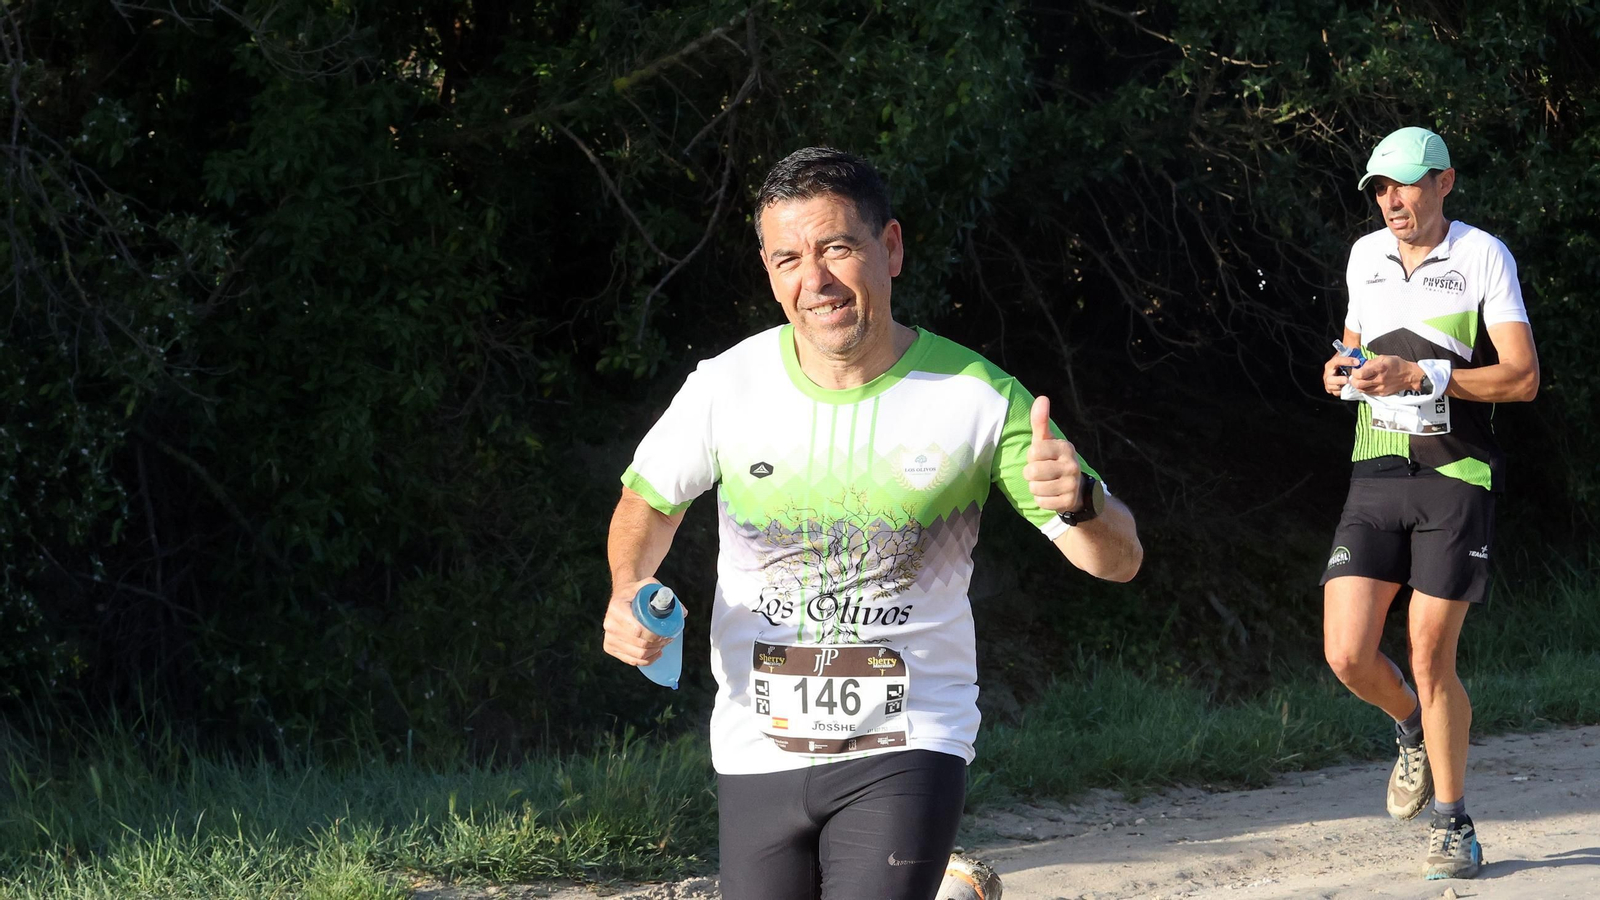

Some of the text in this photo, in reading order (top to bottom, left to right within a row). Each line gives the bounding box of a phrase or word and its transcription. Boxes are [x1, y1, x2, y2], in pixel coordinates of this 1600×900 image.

[1423, 277, 1462, 291] PHYSICAL
[752, 587, 914, 626] Los Olivos
[794, 677, 861, 716] 146
[812, 723, 856, 731] JOSSHE
